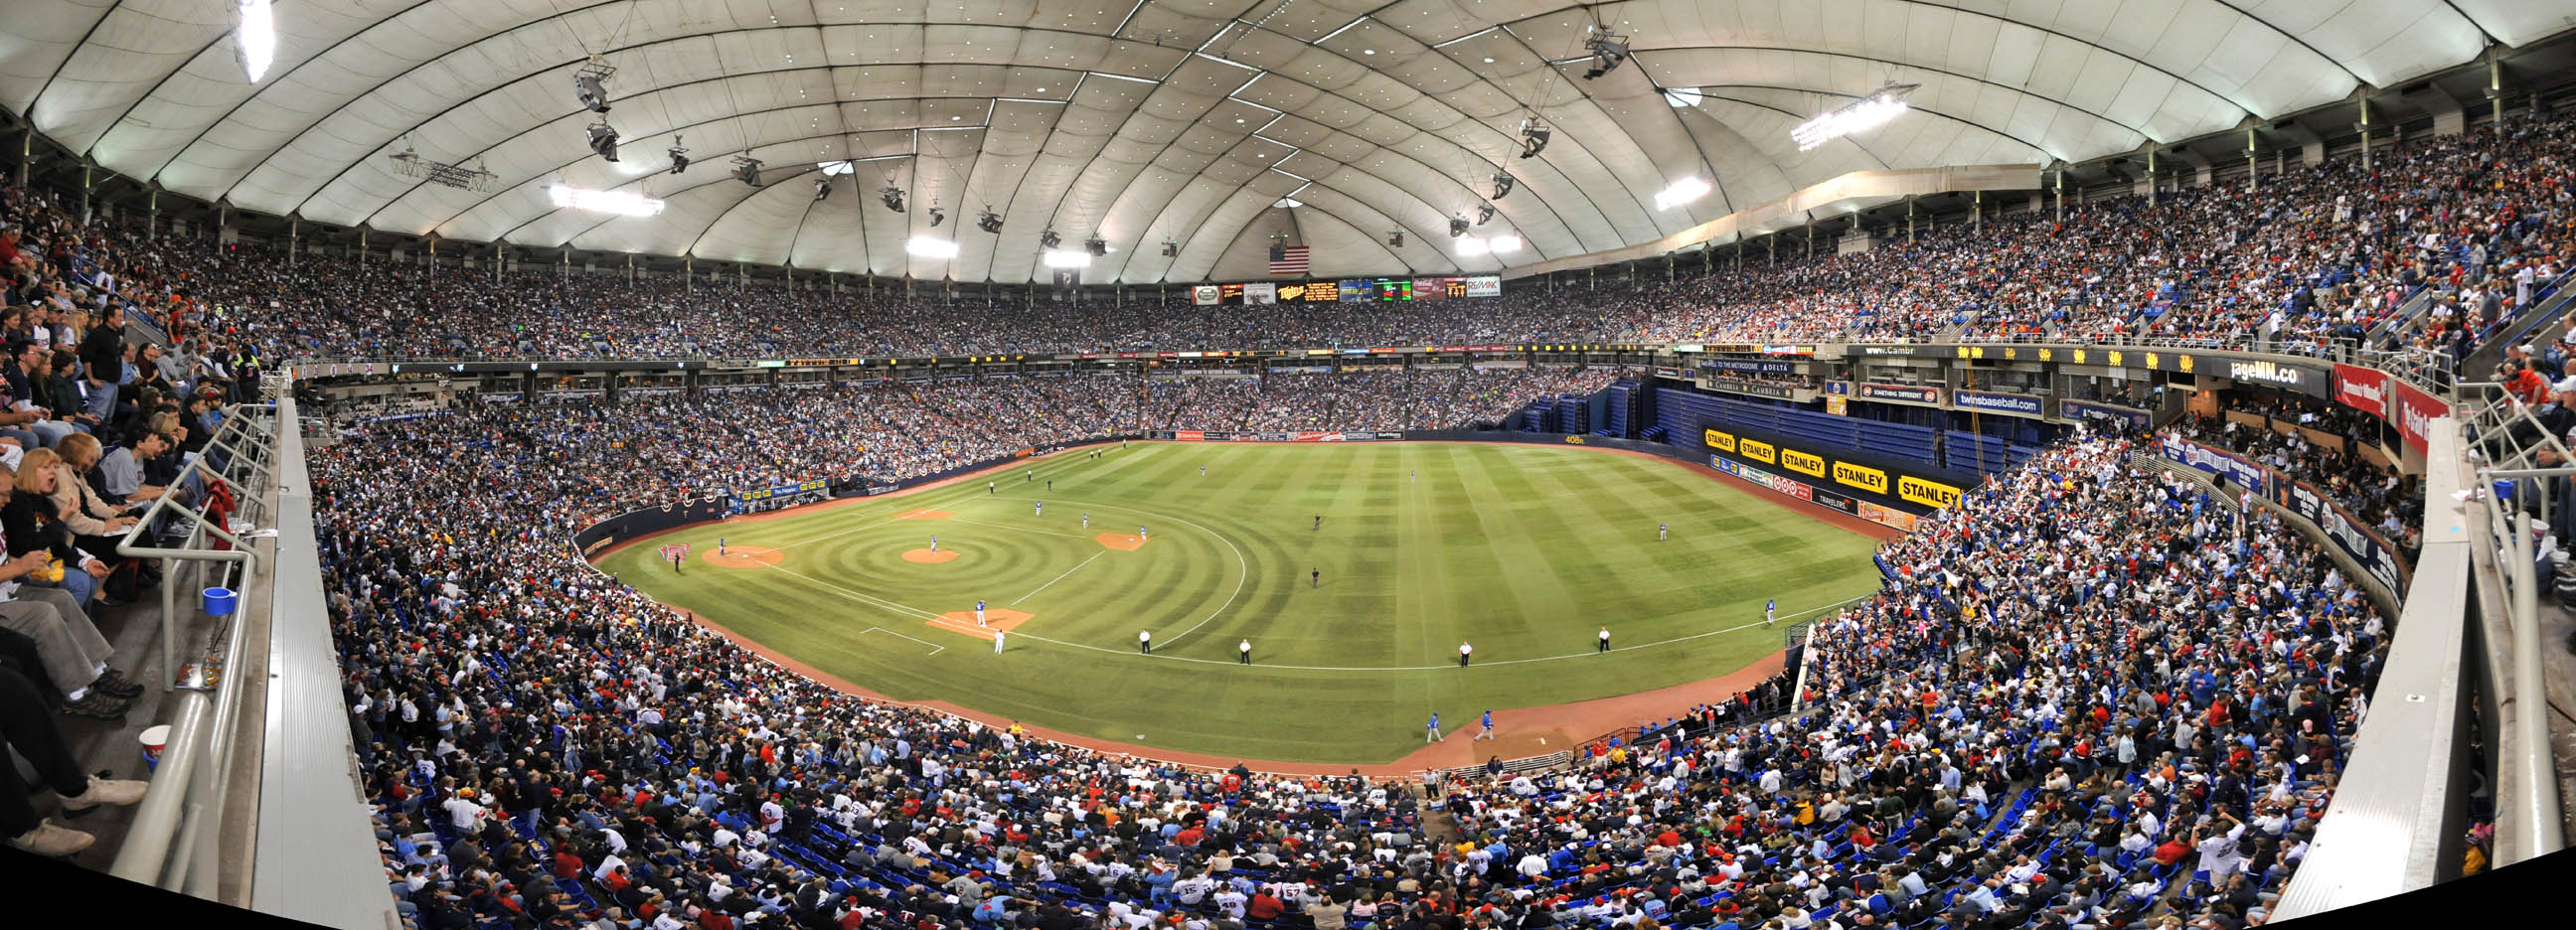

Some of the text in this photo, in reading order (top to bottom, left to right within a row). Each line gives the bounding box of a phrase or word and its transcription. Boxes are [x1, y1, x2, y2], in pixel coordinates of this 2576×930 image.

[1277, 286, 1305, 301] Twins
[1715, 381, 1739, 391] CAMBRIA
[1751, 385, 1780, 396] CAMBRIA
[1873, 388, 1897, 397] SOMETHING
[1961, 393, 2036, 410] twinsbaseball.com
[1707, 433, 1733, 447] STANLEY
[1742, 443, 1772, 459] STANLEY
[1784, 453, 1822, 472] STANLEY
[1837, 467, 1883, 488] STANLEY
[1903, 482, 1959, 505] STANLEY
[1820, 495, 1846, 510] TRAVELERS
